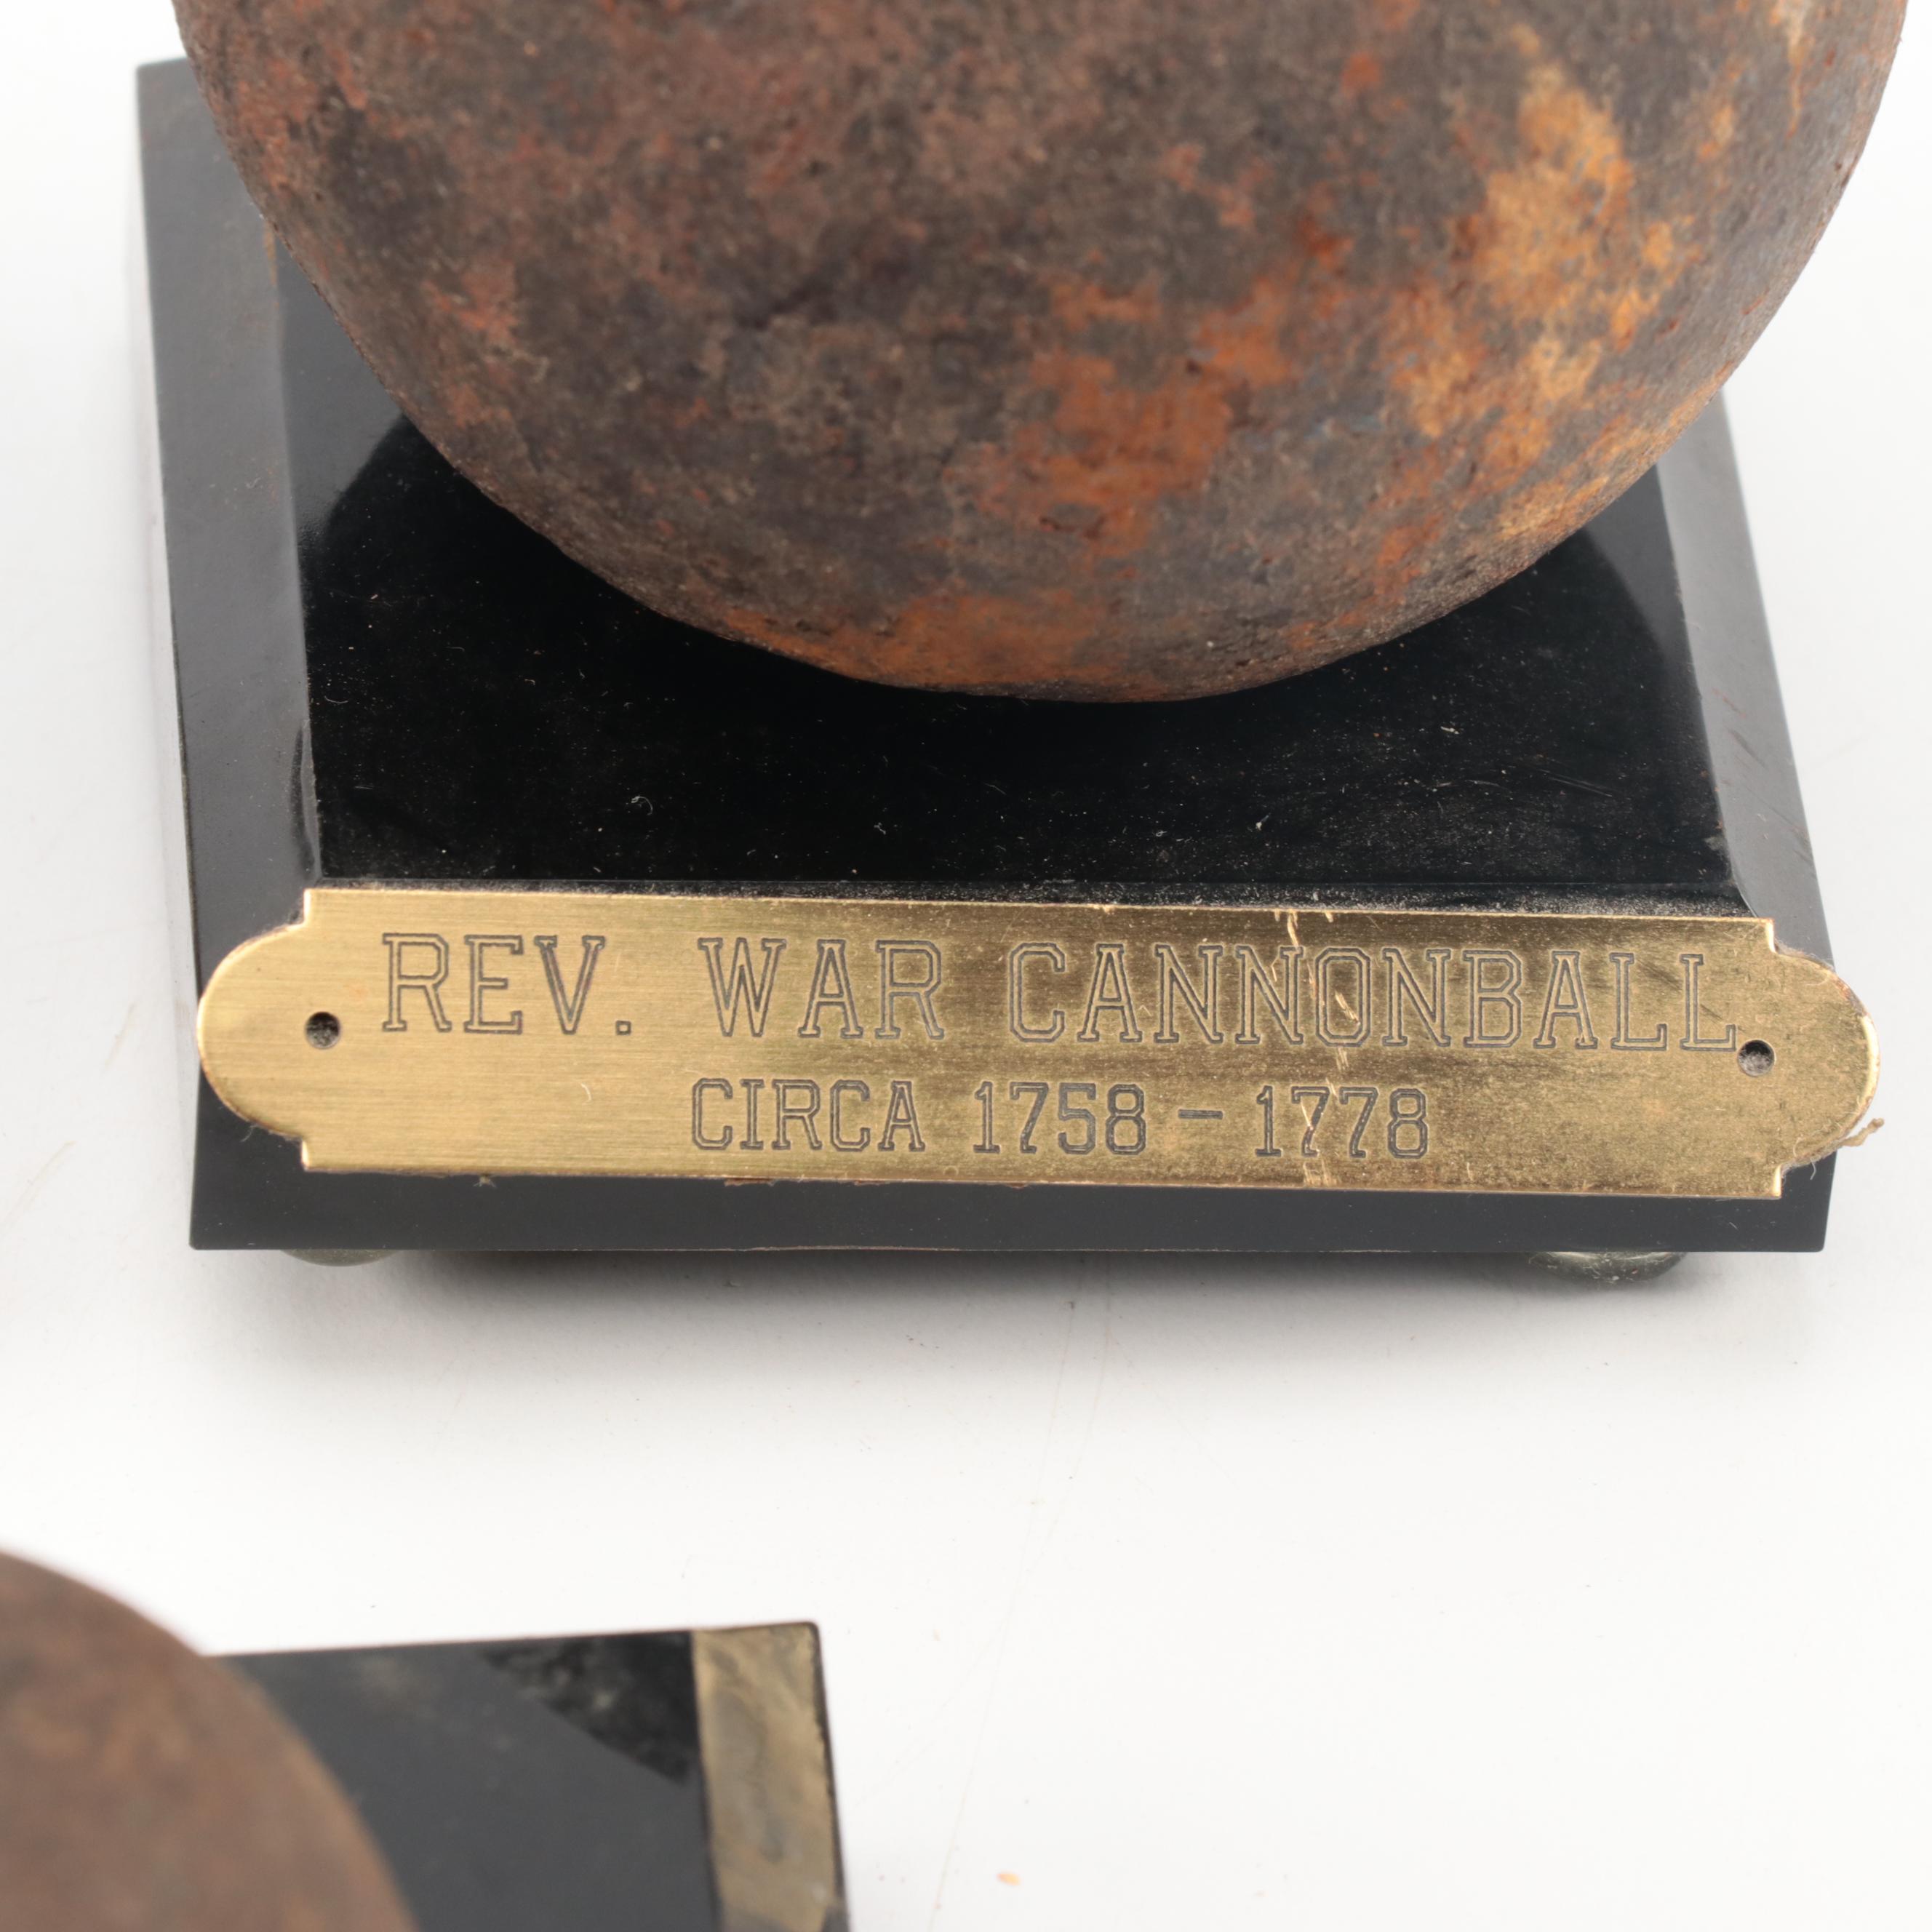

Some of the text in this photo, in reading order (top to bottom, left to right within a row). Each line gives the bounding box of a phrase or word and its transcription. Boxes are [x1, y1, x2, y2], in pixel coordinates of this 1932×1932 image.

[382, 932, 1736, 1052] REV. WAR CANNONBALL
[691, 1078, 1429, 1160] CIRCA 1758 - 1778
